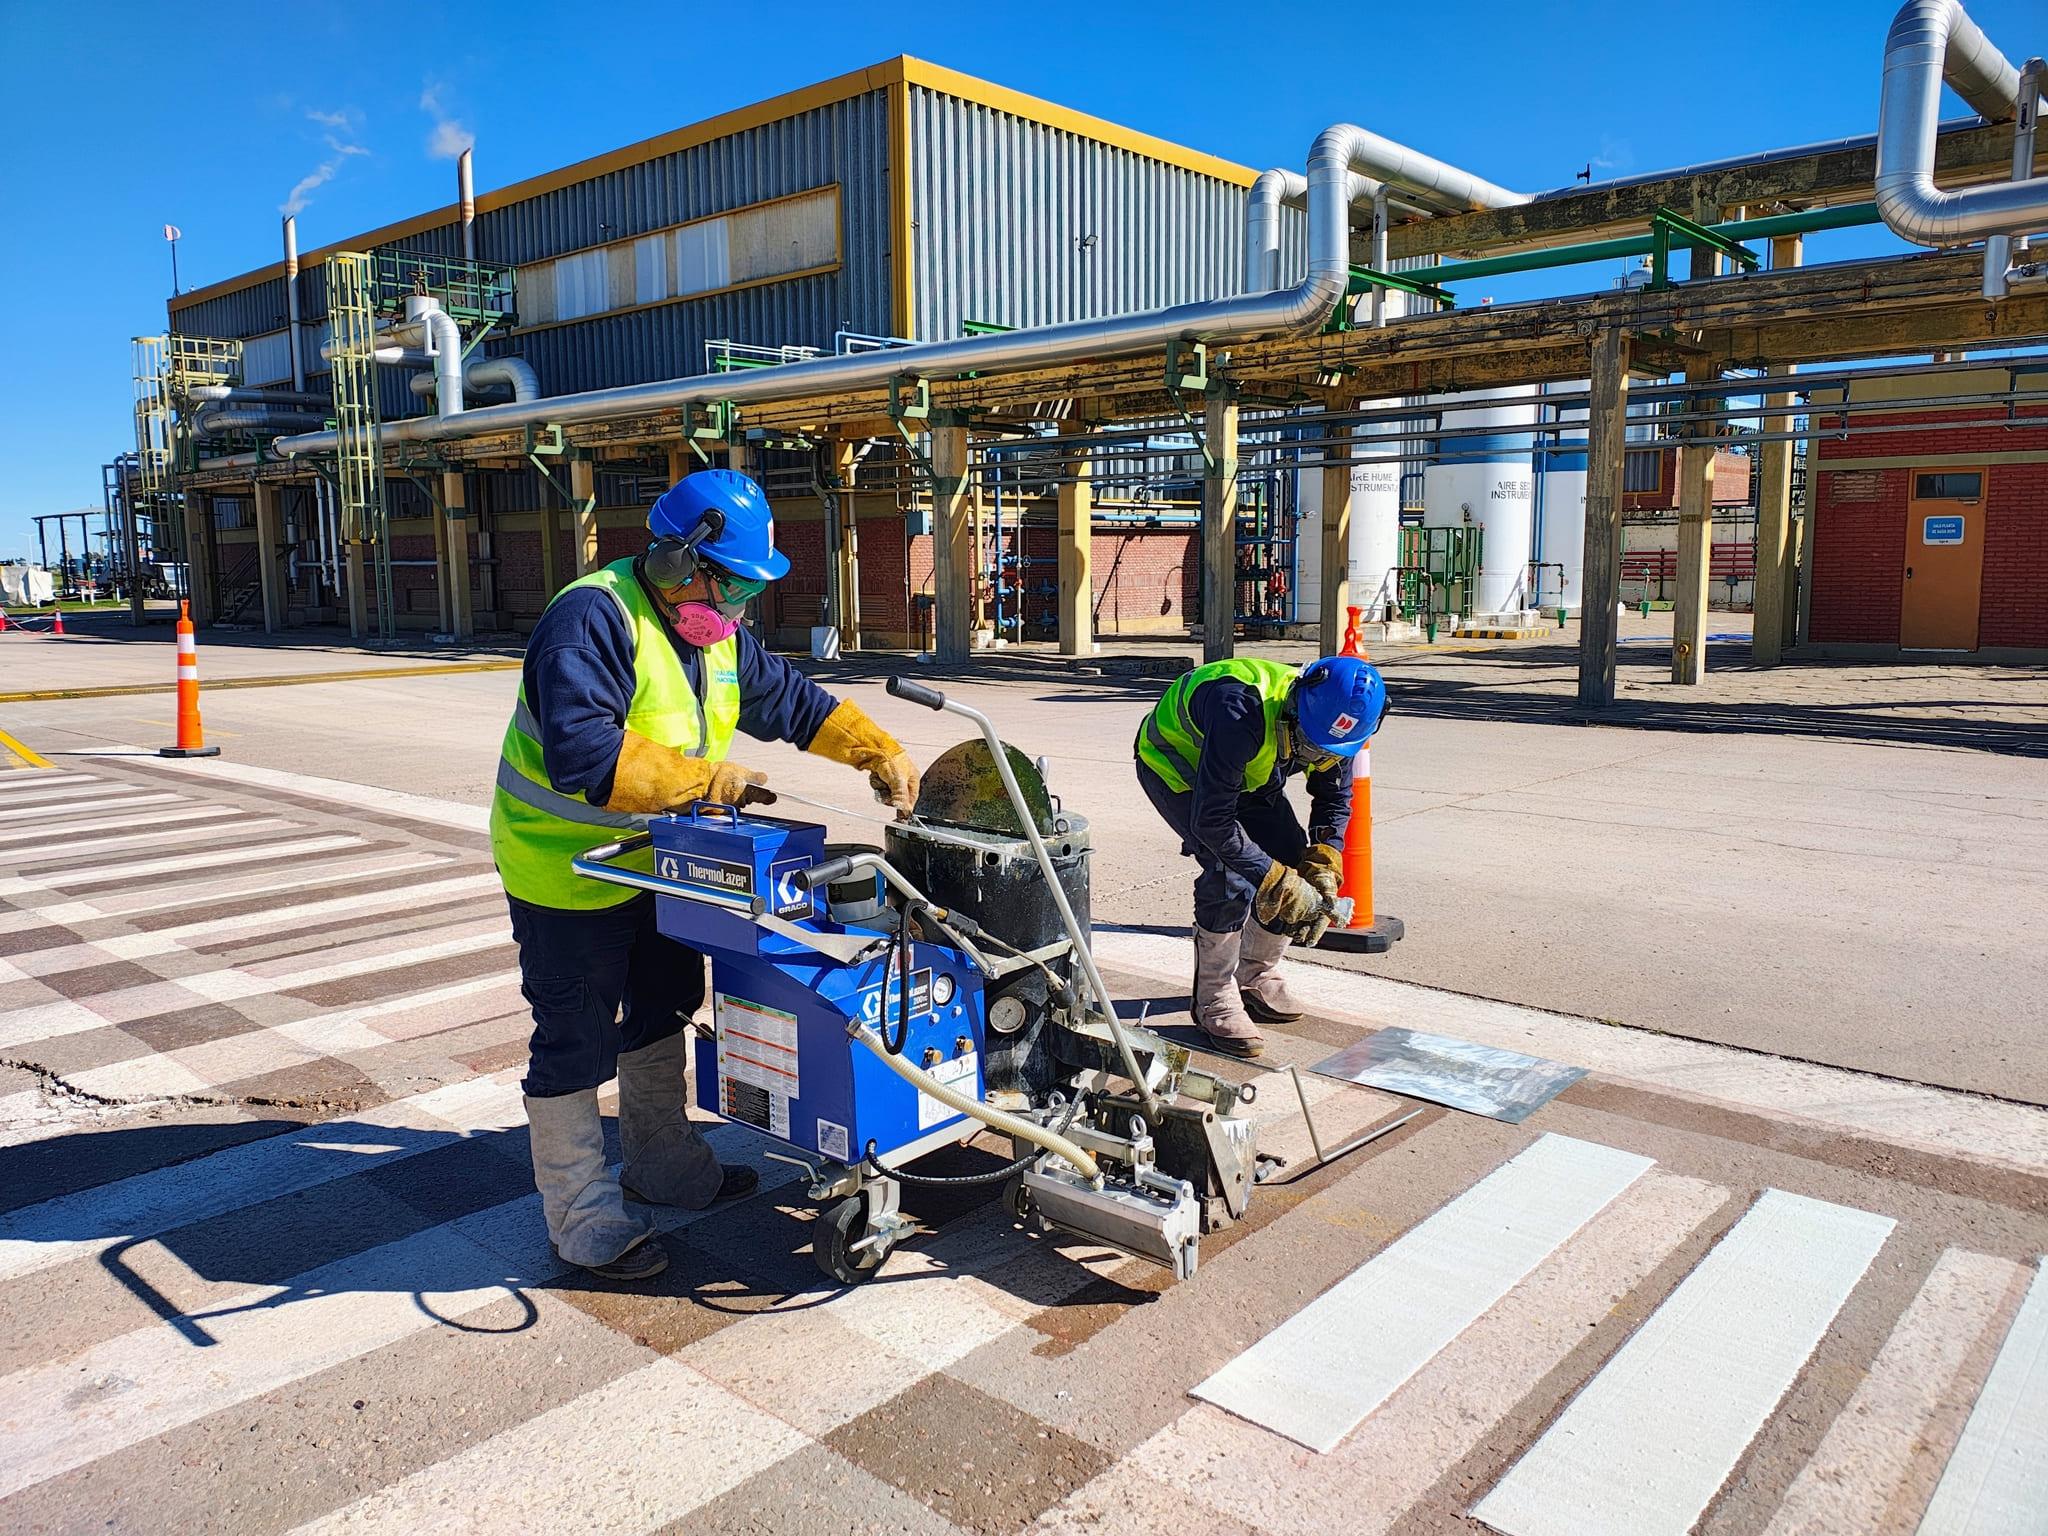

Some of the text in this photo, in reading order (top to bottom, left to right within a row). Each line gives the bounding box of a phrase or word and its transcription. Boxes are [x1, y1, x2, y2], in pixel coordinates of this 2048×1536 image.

[1497, 481, 1517, 490] AIRE
[687, 862, 747, 888] ThermoLazer
[778, 902, 808, 914] GRACO
